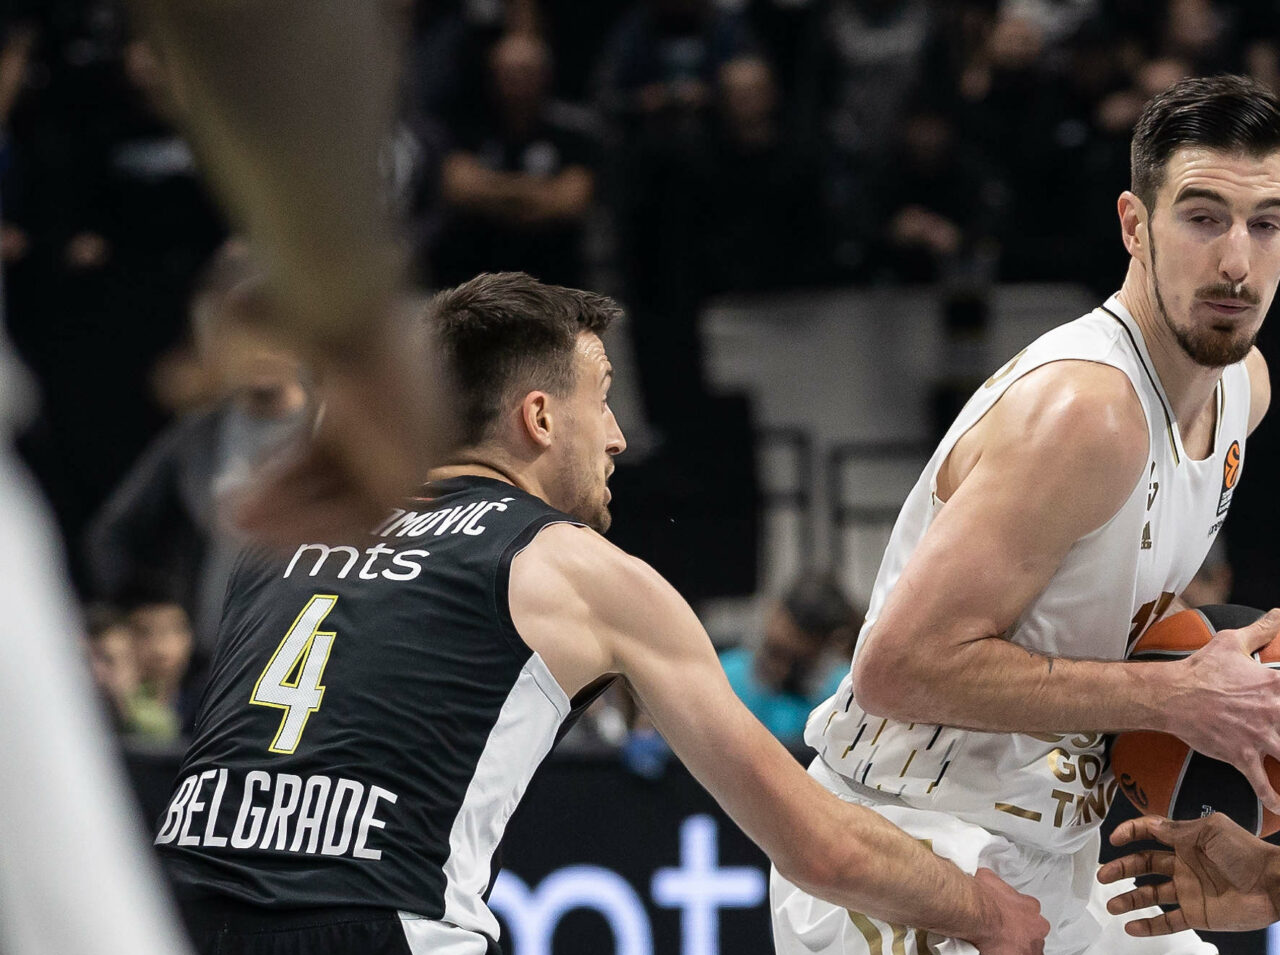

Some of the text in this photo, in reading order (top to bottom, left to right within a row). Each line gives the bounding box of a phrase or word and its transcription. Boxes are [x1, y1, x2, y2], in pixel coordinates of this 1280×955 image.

[283, 542, 430, 581] mts
[249, 594, 339, 755] 4
[154, 768, 398, 861] BELGRADE
